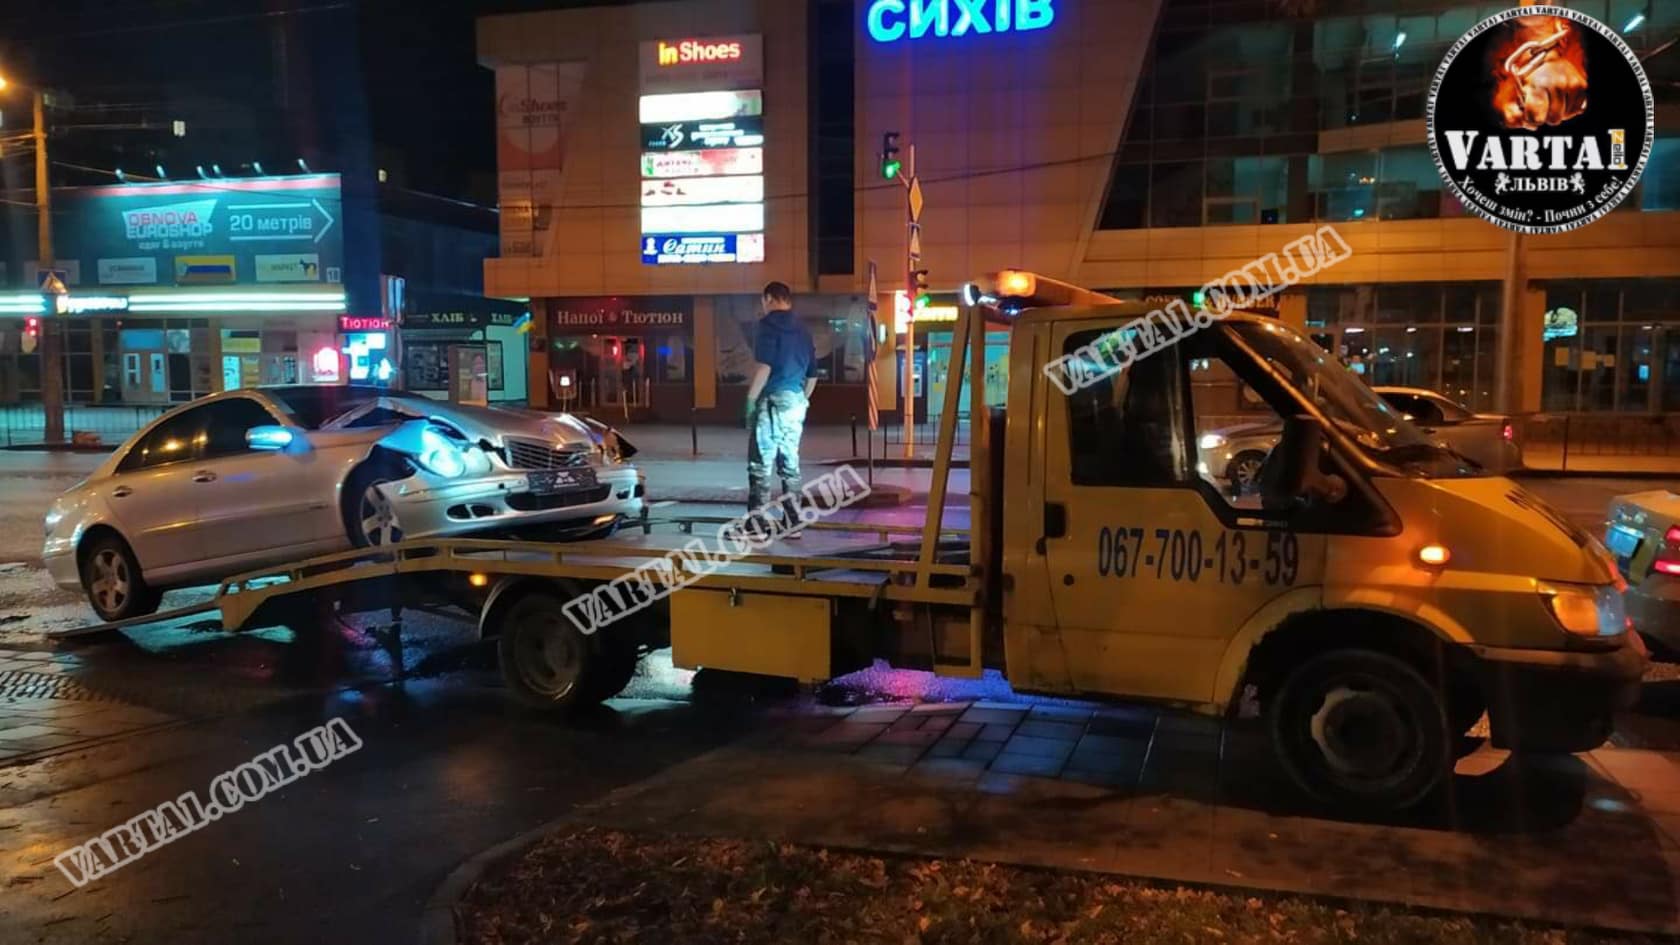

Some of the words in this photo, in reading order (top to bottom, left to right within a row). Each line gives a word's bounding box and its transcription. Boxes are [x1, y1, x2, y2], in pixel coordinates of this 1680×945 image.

[868, 0, 1054, 42] СИХІВ
[680, 41, 740, 60] Shoes
[126, 223, 213, 239] EUROSHOP
[229, 215, 253, 231] 20
[257, 216, 312, 233] метрів
[431, 313, 464, 323] ХЛІБ
[557, 310, 603, 325] Напої
[1099, 527, 1298, 586] 067-700-13-59
